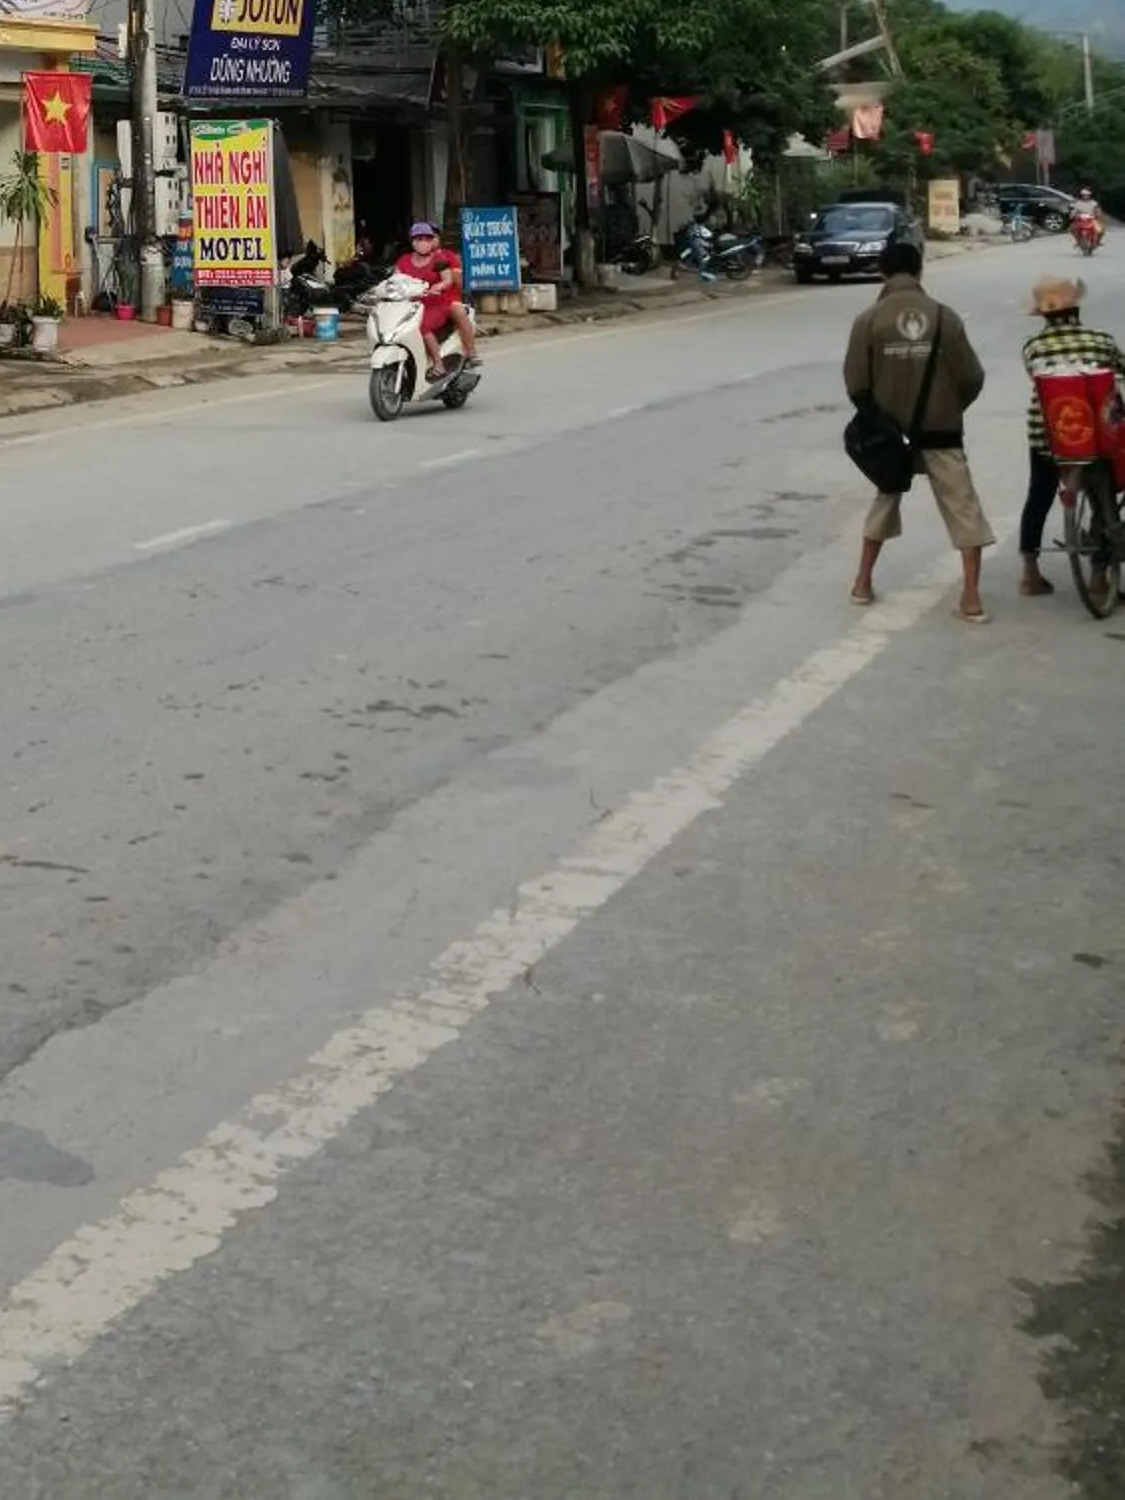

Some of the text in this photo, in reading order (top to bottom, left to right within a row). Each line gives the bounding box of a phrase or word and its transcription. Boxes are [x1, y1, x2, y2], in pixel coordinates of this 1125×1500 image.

[230, 35, 282, 52] ĐẠI LÝ SƠN
[194, 136, 268, 185] NHÀ NGHỈ
[195, 187, 268, 229] THIÊN ÂN
[200, 237, 267, 260] MOTEL
